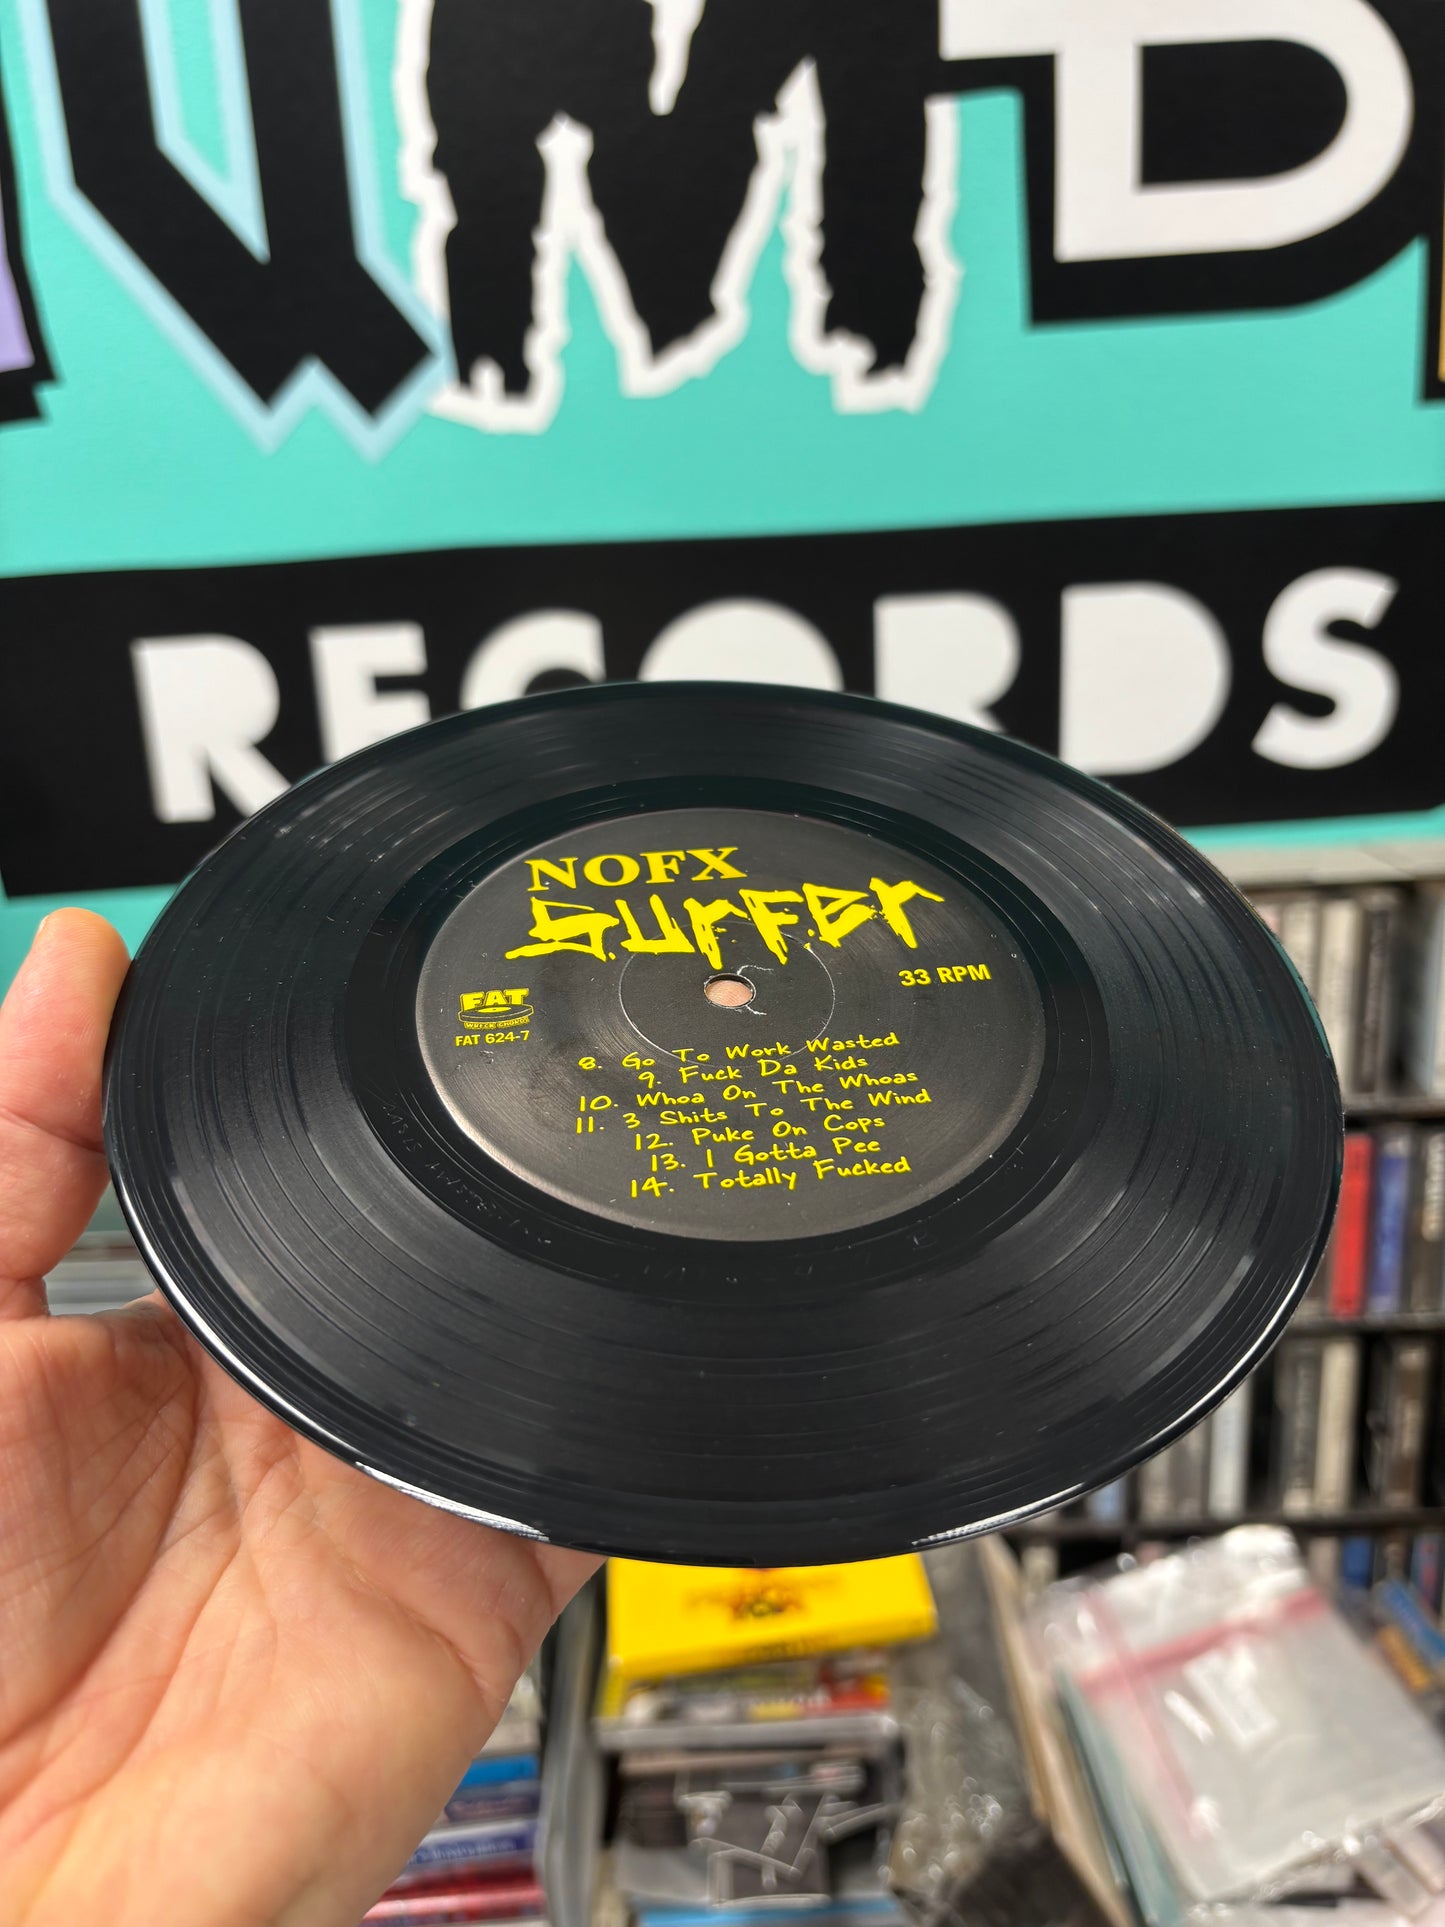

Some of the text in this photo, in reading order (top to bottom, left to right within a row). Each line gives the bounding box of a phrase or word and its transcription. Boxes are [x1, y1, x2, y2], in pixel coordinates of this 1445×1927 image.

[524, 846, 747, 893] NOFX
[898, 963, 991, 987] 33 RPM
[459, 987, 530, 1013] FAT
[454, 1030, 530, 1047] FAT 624-7
[577, 1031, 901, 1071] 8. Go To Work Wasted
[637, 1054, 869, 1090] 9. Fuck Da Kids
[576, 1088, 933, 1135] 11. 3 Shits To The Wind
[579, 1072, 919, 1113] 10. Whoa On The Whoas
[635, 1114, 887, 1152] 12. Puke On Cops
[651, 1153, 687, 1173] 13.
[733, 1142, 818, 1167] Gotta
[831, 1137, 882, 1156] Pee
[630, 1156, 912, 1199] 14. Totally Fucked
